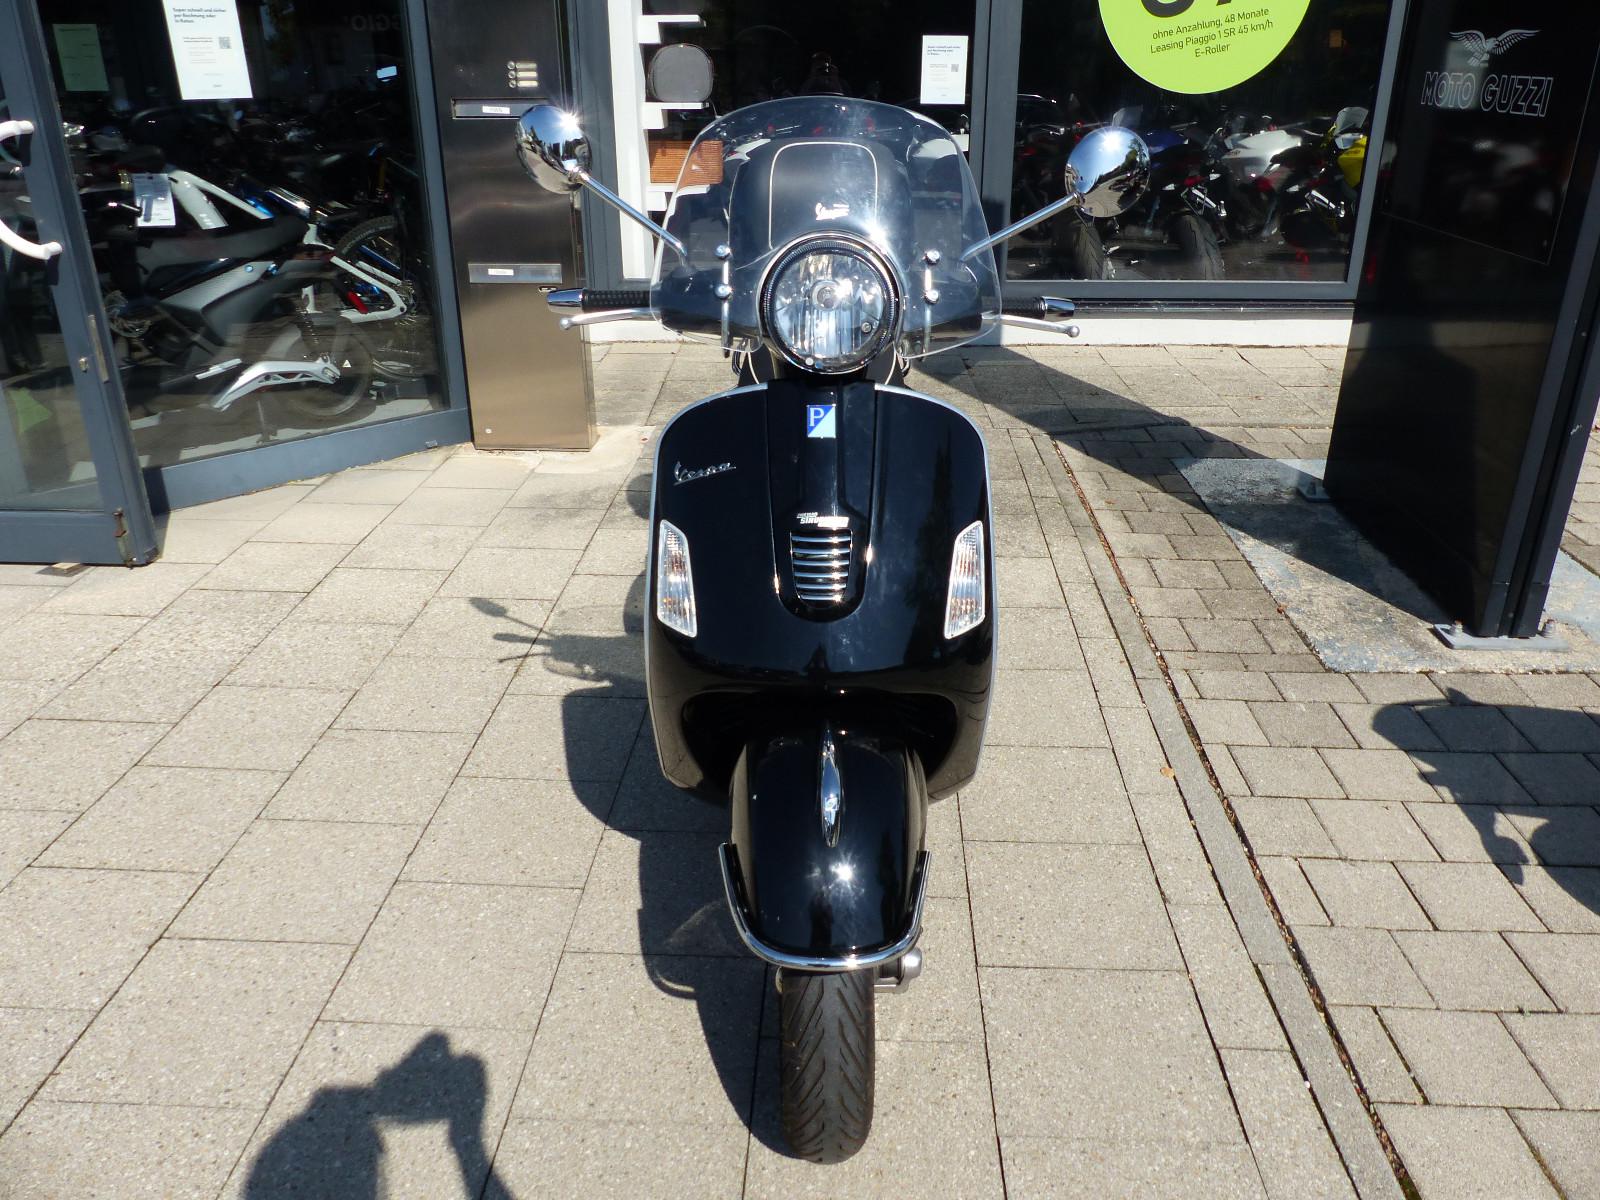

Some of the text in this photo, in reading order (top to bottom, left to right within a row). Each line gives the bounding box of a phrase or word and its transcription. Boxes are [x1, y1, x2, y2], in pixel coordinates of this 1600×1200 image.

[1150, 40, 1184, 54] Leasing
[1185, 33, 1217, 46] Piaggio
[1223, 27, 1236, 38] SR
[1238, 24, 1249, 35] 45
[1250, 18, 1273, 33] km/h
[1152, 28, 1174, 40] ohne
[1175, 19, 1222, 34] Anzahlung,
[1224, 13, 1236, 24] 48
[1237, 8, 1270, 21] Monate
[1194, 43, 1231, 58] E-Roller
[1420, 71, 1554, 118] MOTO GUZZI
[673, 461, 737, 486] Vespa
